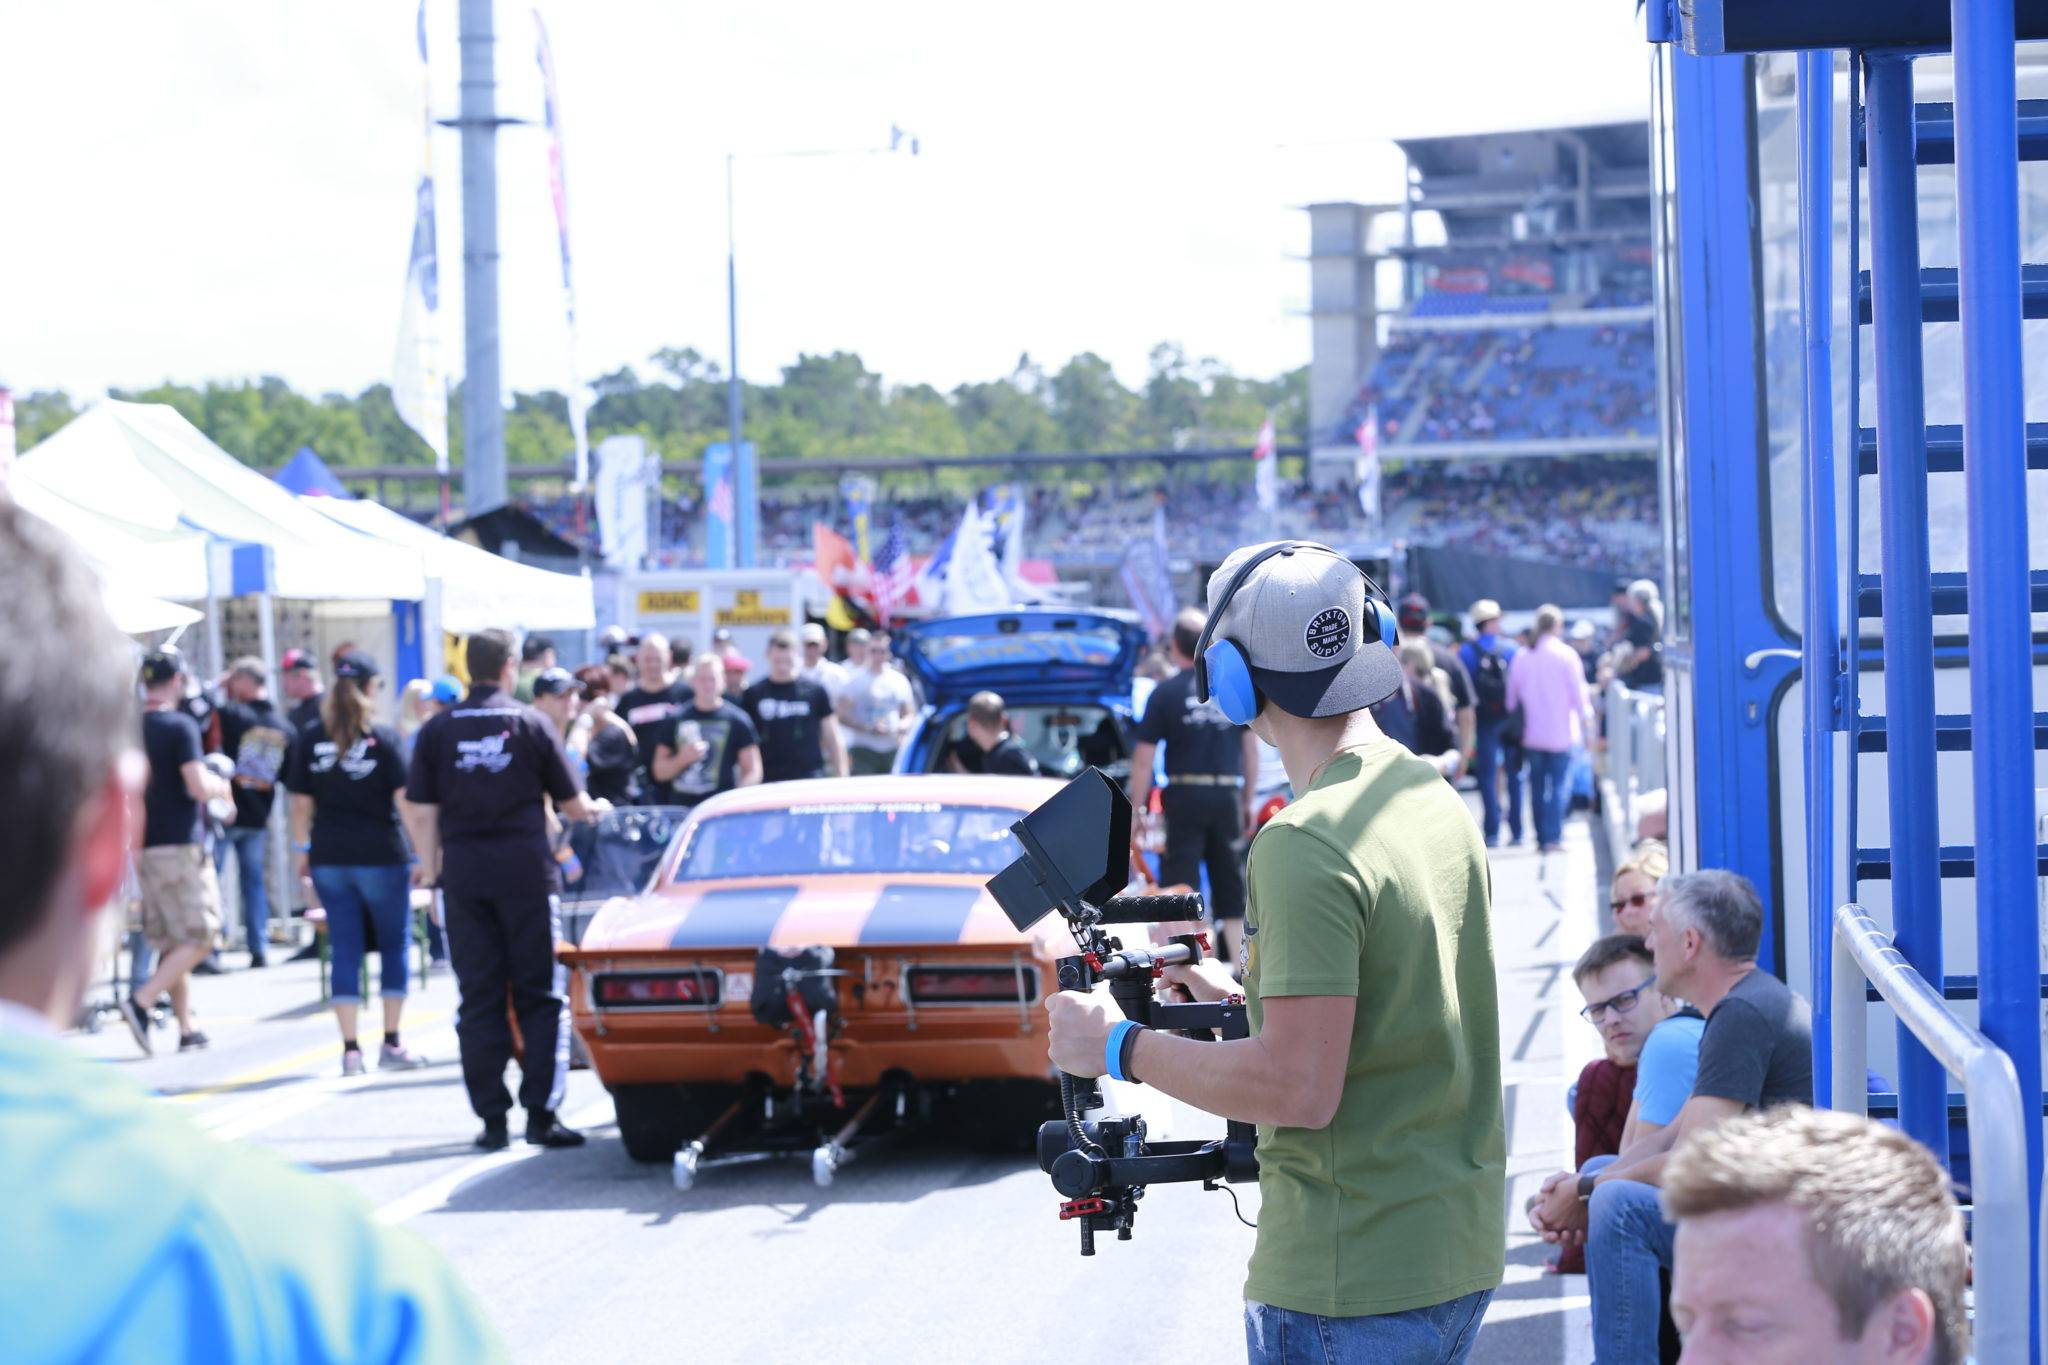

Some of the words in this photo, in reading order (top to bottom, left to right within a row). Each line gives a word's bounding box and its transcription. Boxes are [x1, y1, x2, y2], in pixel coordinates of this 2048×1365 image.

[1308, 611, 1347, 635] BRIXTON
[1322, 623, 1338, 633] TRADE
[1311, 634, 1347, 656] SUPPLY
[1322, 635, 1338, 644] MARK
